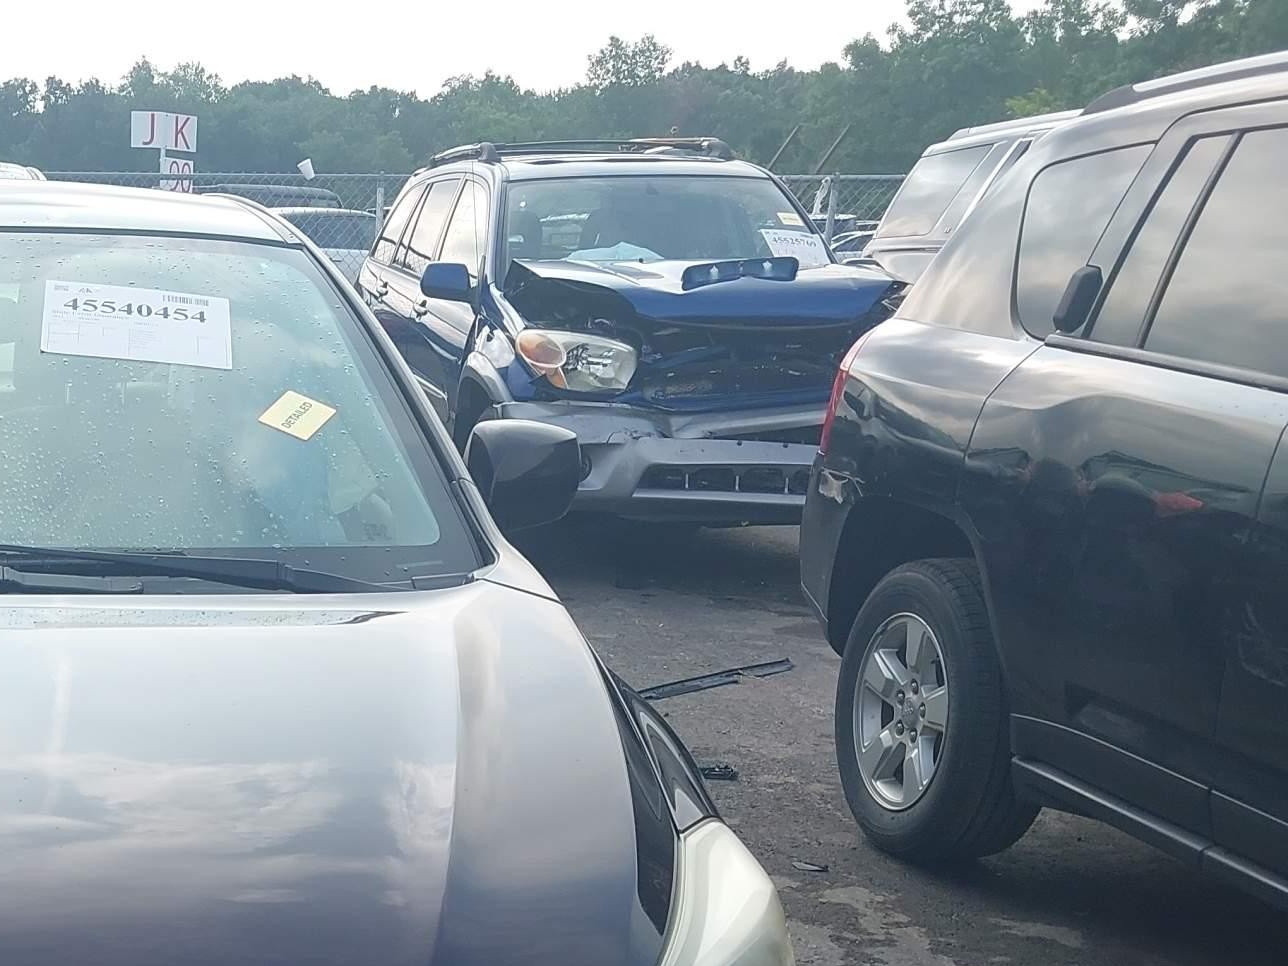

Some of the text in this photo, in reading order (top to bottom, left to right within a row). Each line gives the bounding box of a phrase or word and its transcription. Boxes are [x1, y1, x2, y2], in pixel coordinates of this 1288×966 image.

[142, 113, 191, 150] J K
[63, 297, 208, 323] 45540454
[280, 401, 313, 429] DETAILED
